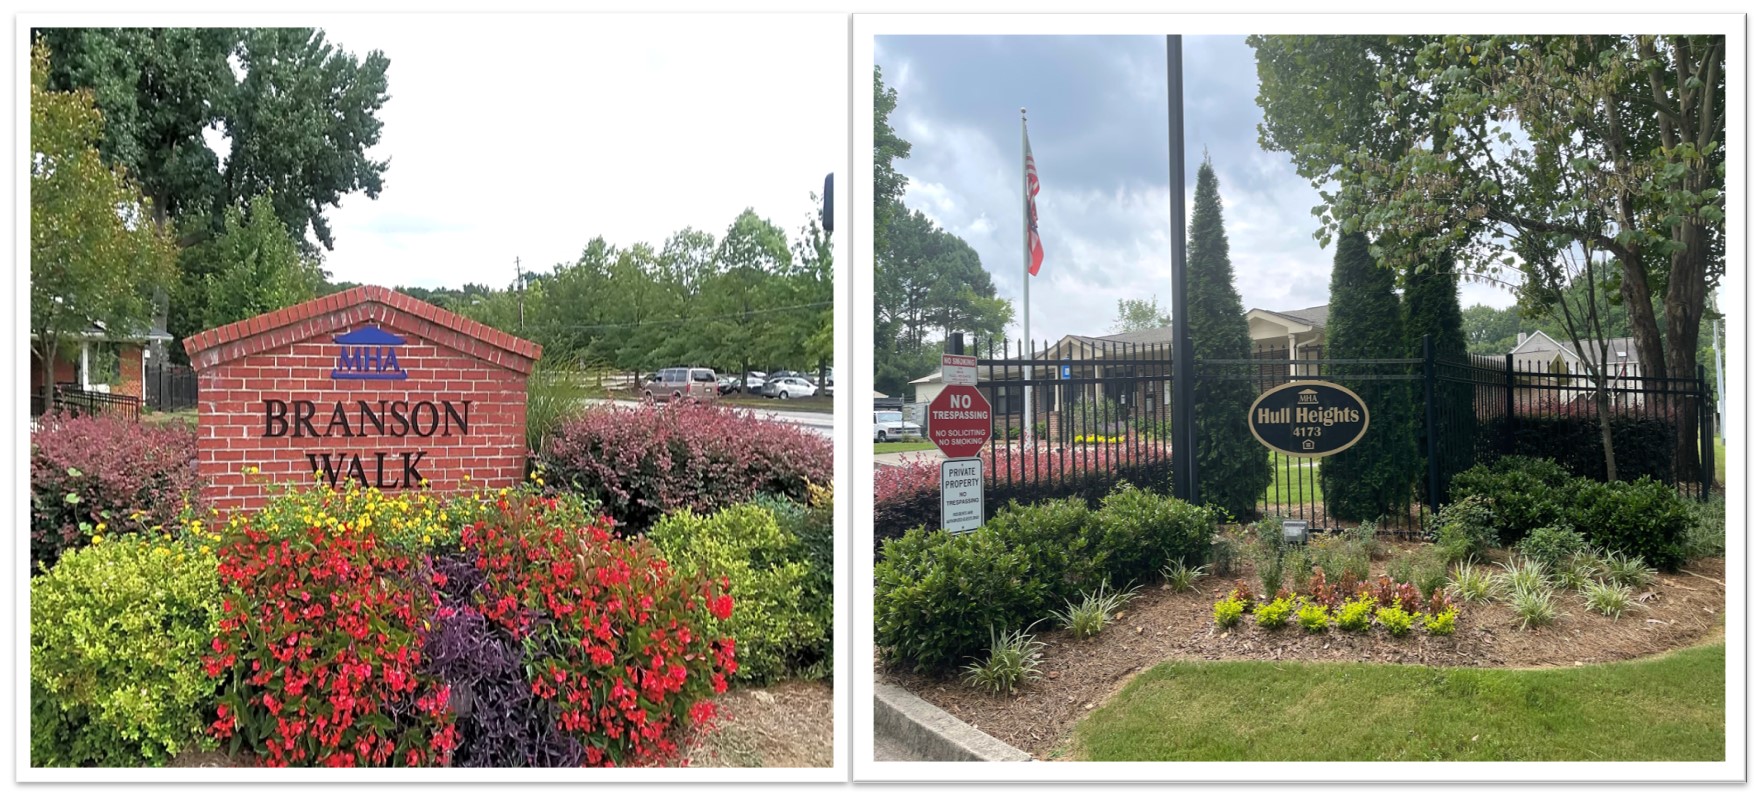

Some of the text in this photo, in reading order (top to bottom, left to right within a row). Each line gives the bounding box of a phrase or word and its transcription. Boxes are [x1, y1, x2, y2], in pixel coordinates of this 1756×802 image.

[339, 346, 400, 372] MHA
[950, 394, 971, 408] NO
[262, 399, 472, 437] BRANSON
[932, 410, 988, 420] TRESPASSING
[1258, 406, 1360, 426] Hull Heights
[1293, 427, 1322, 437] 4173
[306, 452, 430, 488] WALK
[949, 467, 976, 477] PRIVATE
[945, 478, 979, 489] PROPERTY
[946, 498, 979, 506] TRESPASSING
